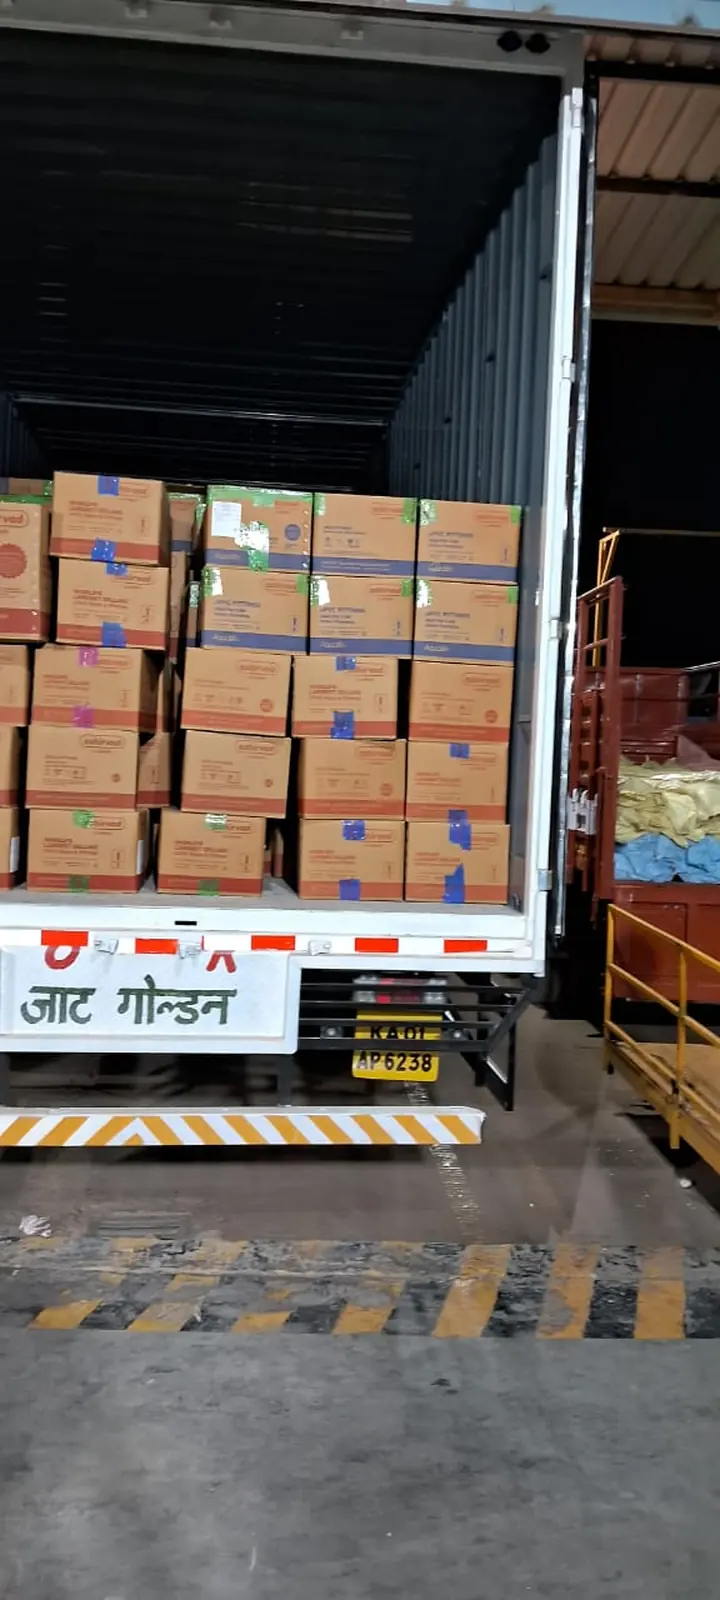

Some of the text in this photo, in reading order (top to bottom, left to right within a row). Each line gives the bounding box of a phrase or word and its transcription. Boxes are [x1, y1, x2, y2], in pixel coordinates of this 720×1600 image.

[20, 974, 237, 1025] जाट गोल्डन
[357, 1050, 432, 1072] AP6238
